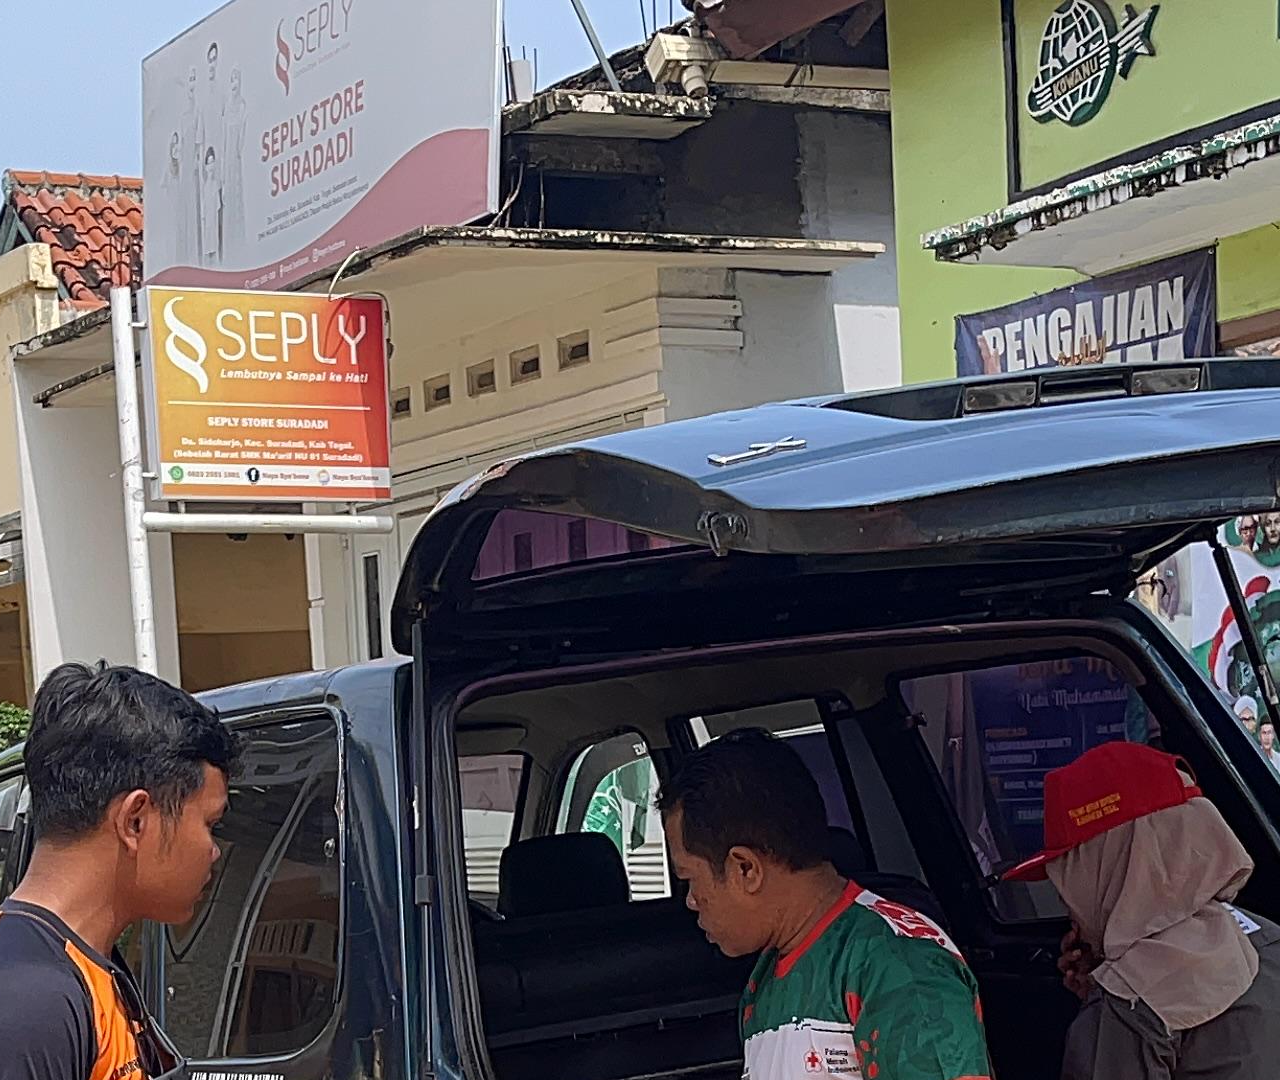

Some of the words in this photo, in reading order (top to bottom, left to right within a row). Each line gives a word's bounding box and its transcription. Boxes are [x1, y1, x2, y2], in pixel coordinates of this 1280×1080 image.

[294, 0, 353, 61] SEPLY
[1052, 58, 1099, 99] KOWANU
[261, 110, 308, 162] SEPLY
[310, 80, 365, 136] STORE
[271, 127, 353, 197] SURADADI
[215, 308, 367, 365] SEPLY
[982, 276, 1185, 373] PENGAJIAN
[220, 367, 282, 381] Lembutnya
[286, 370, 327, 383] Sampai
[329, 372, 342, 383] ke
[345, 373, 368, 384] Hati
[207, 416, 239, 427] SEPLY
[241, 417, 274, 428] STORE
[276, 418, 329, 430] SURADADI
